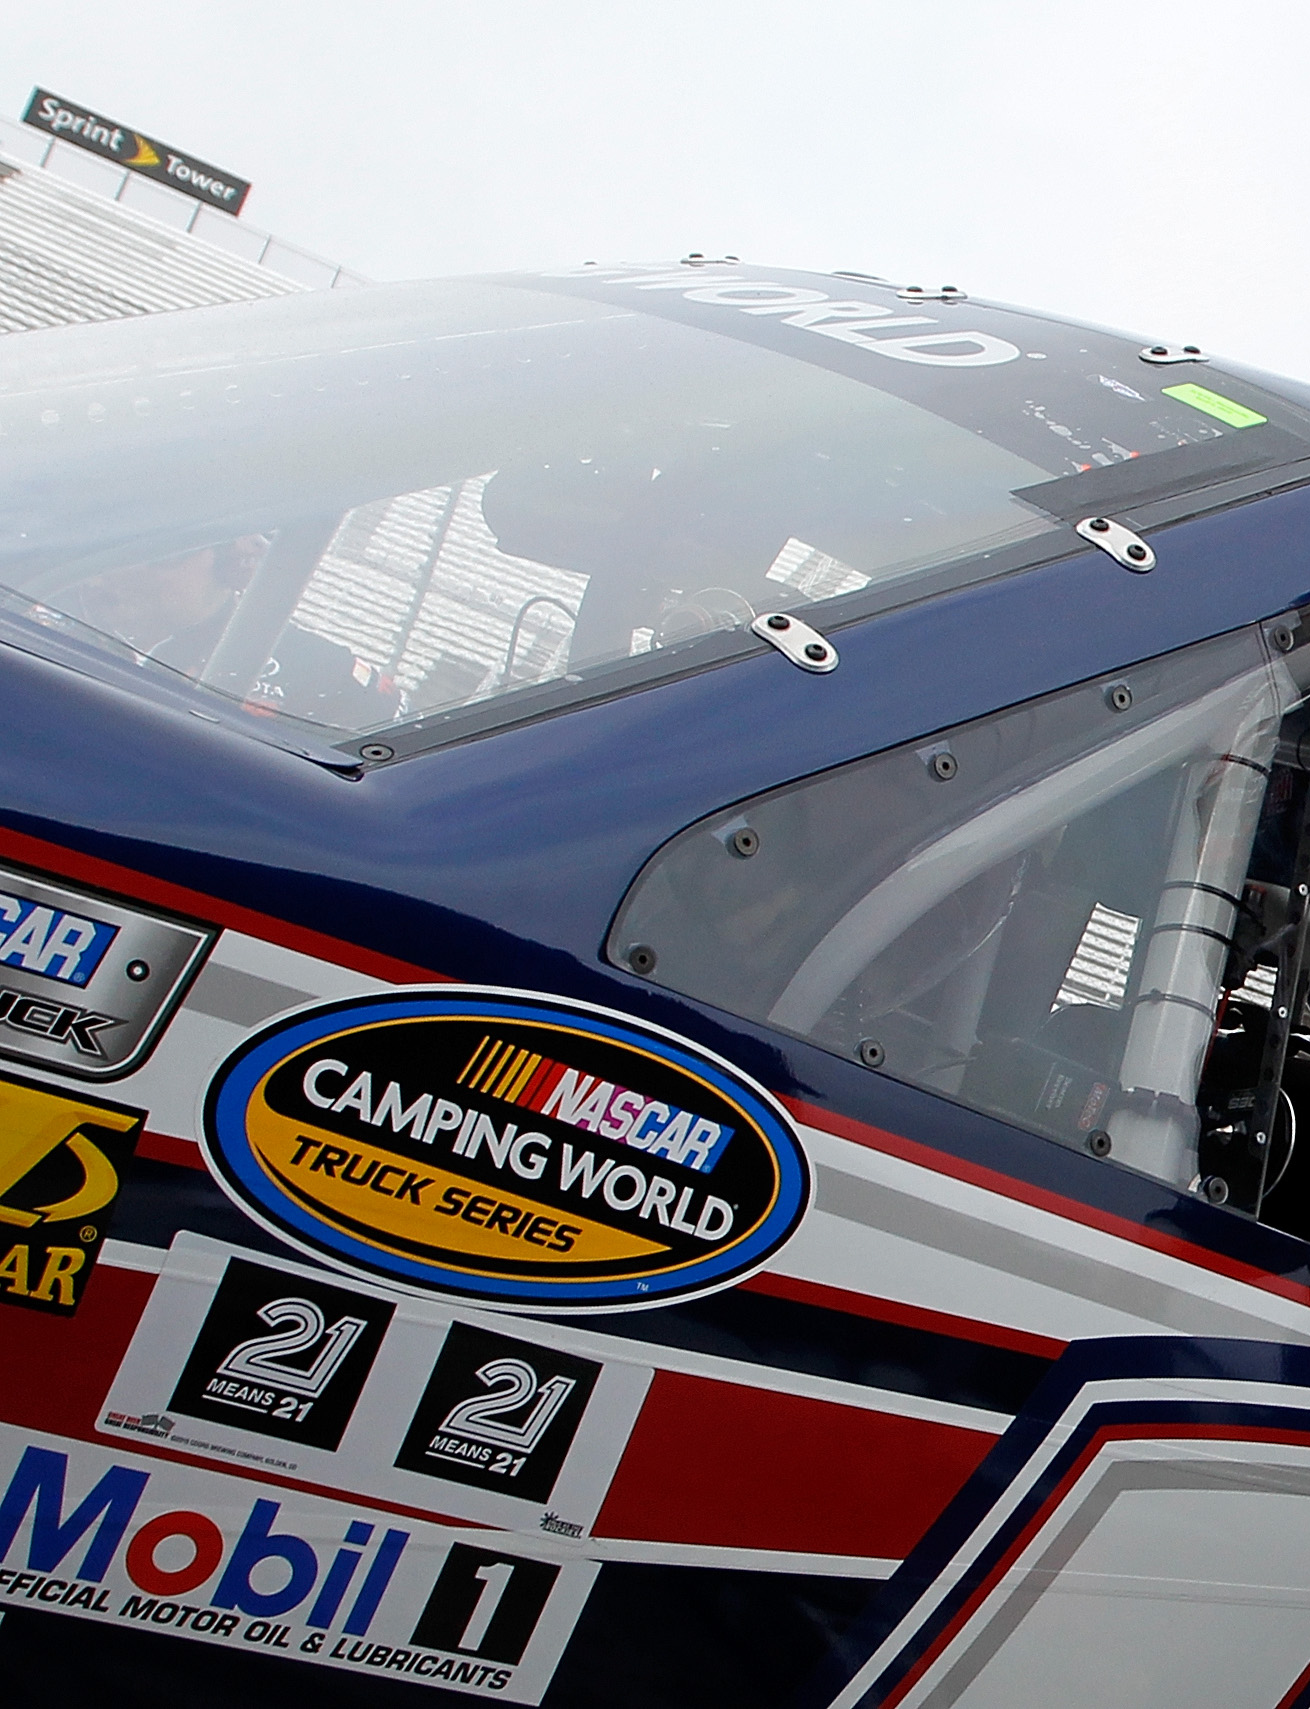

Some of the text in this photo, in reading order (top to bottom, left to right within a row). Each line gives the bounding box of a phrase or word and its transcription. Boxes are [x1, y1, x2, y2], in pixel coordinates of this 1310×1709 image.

[37, 97, 240, 201] Sprint Tower
[302, 1058, 735, 1242] CAMPING WORLD
[539, 1067, 721, 1172] NASCAR
[289, 1135, 584, 1254] TRUCK SERIES
[206, 1377, 314, 1423] MEANS 21
[215, 1297, 369, 1400] 21
[428, 1434, 528, 1477] MEANS 21
[437, 1357, 577, 1454] 21
[0, 1446, 515, 1652] Mobil 1
[119, 1595, 248, 1637] MOTOR
[243, 1622, 290, 1649] OIL
[300, 1633, 324, 1655] &
[329, 1637, 513, 1691] LUBRICANTS
